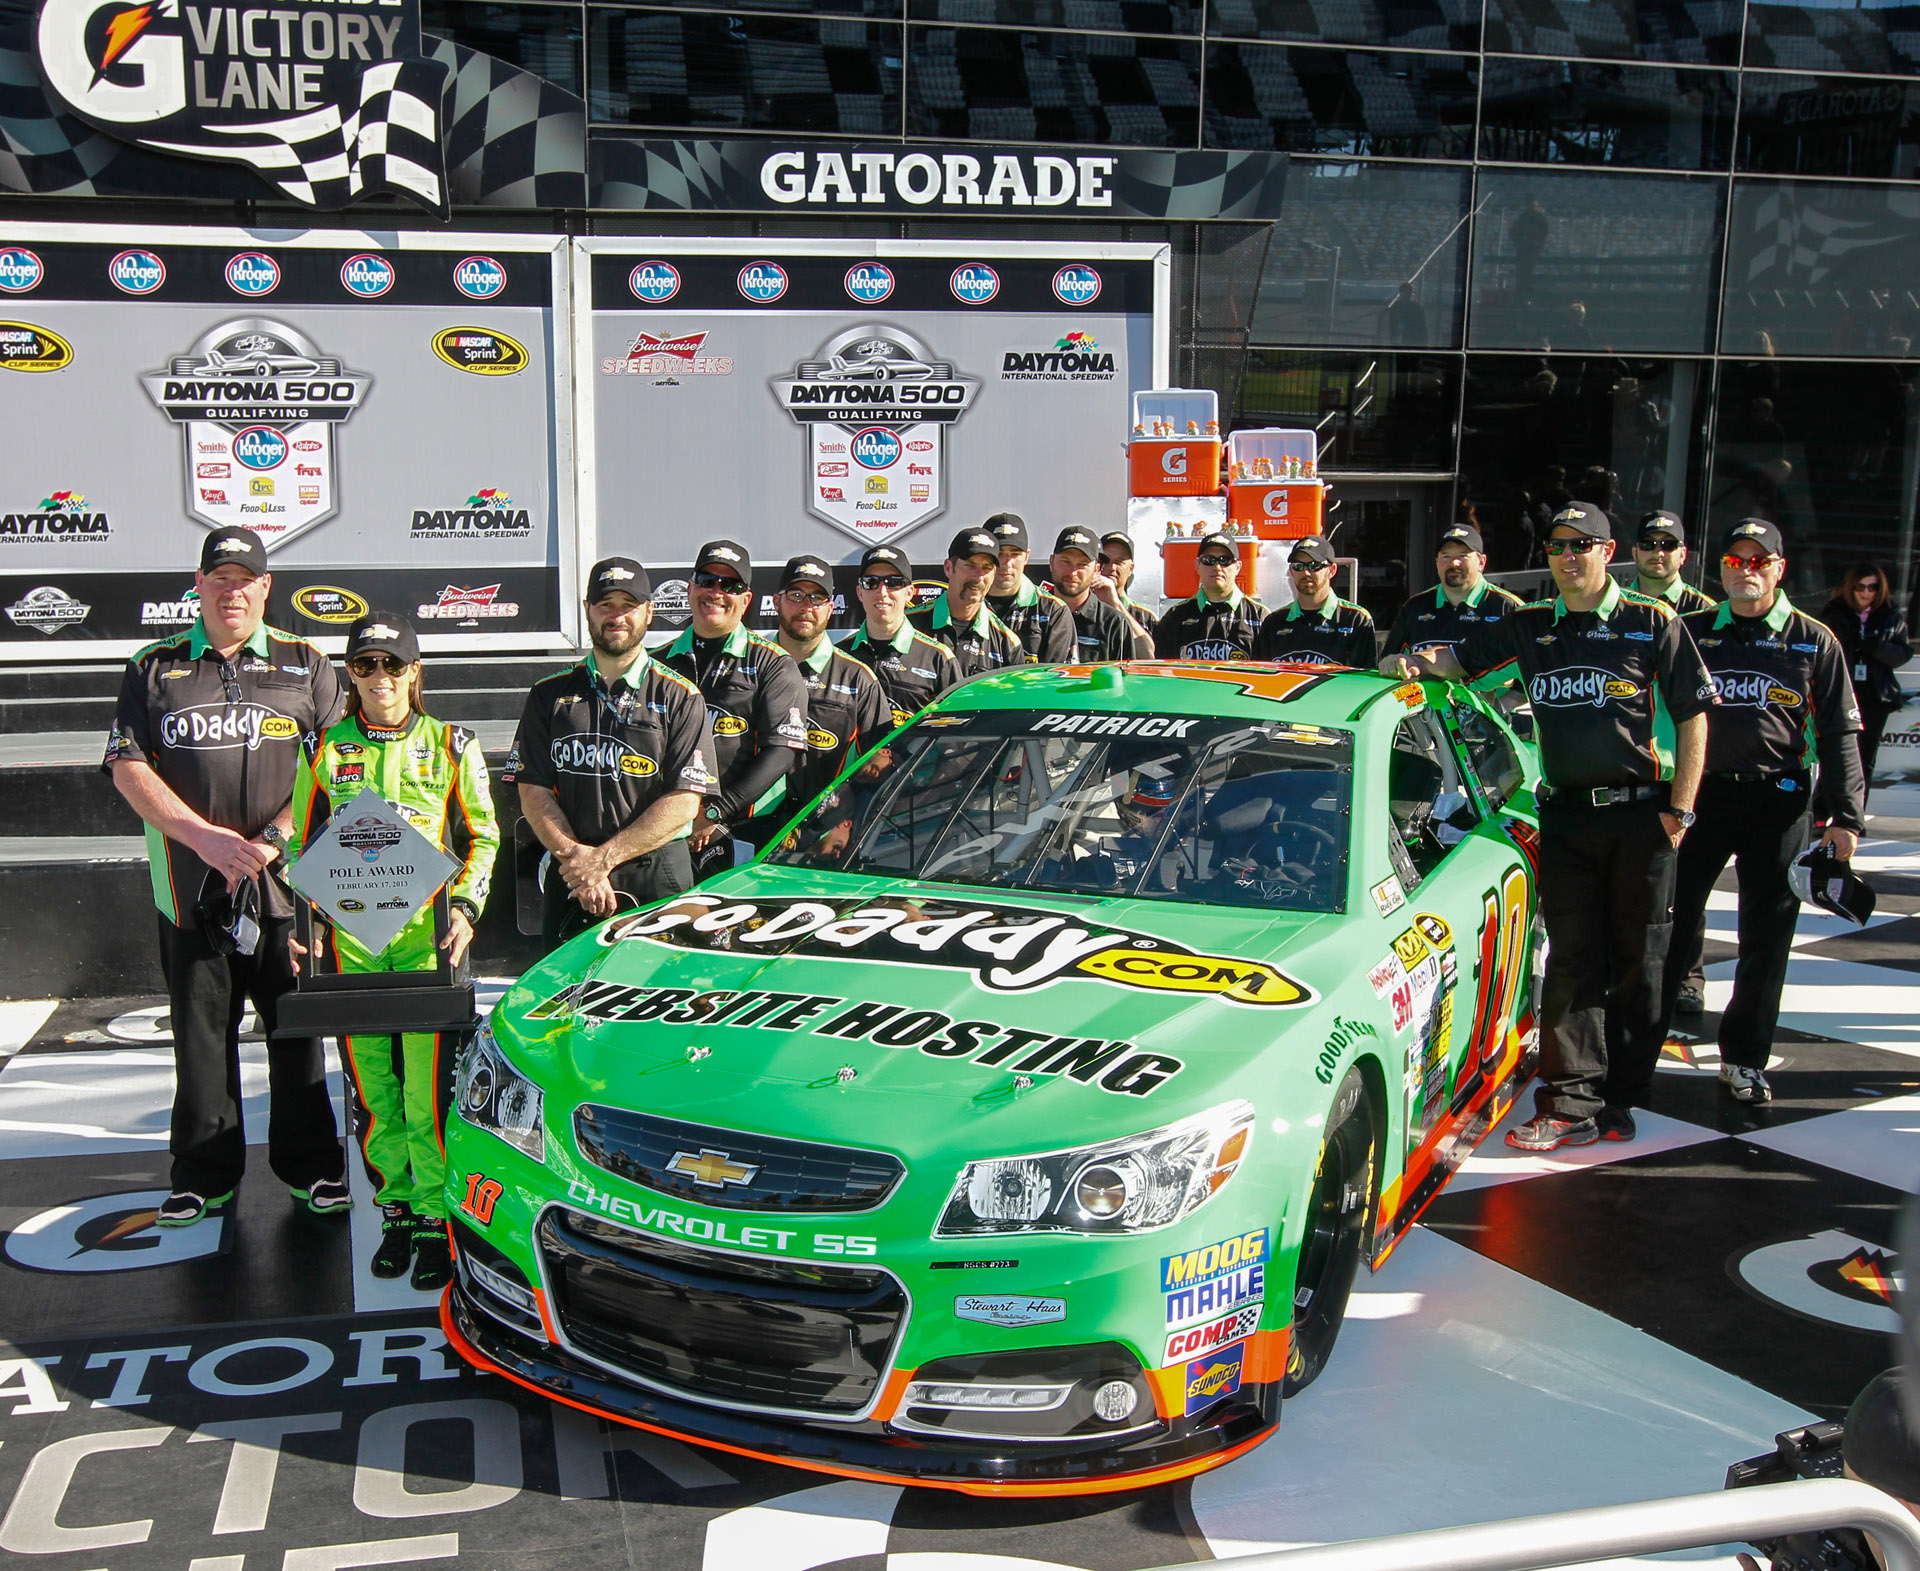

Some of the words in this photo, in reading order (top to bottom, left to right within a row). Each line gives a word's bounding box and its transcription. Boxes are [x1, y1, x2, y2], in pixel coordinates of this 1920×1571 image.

[186, 6, 404, 60] VICTORY
[194, 61, 325, 111] LANE
[760, 151, 1113, 208] GATORADE
[117, 256, 160, 289] Kroger
[234, 258, 275, 290] Kroger
[348, 260, 390, 292] Kroger
[461, 262, 502, 293] Kroger
[636, 265, 677, 297] Kroger
[744, 266, 785, 298] Kroger
[851, 267, 892, 298] Kroger
[957, 268, 997, 299] Kroger
[1058, 269, 1098, 300] Kroger
[4, 343, 38, 357] Sprint
[459, 337, 492, 347] NASCAR
[626, 338, 706, 352] Budweiser
[464, 347, 497, 359] Sprint
[1002, 353, 1115, 372] DAYTONA
[600, 357, 734, 375] SPEEDWEEKS
[1001, 373, 1067, 381] INTERNATIONAL
[1070, 372, 1115, 381] SPEEDWAY
[164, 381, 279, 401] DAYTONA
[283, 382, 355, 402] 500
[789, 385, 896, 404] DAYTONA
[899, 386, 965, 404] 500
[205, 408, 310, 418] QUALIFYING
[827, 410, 923, 420] QUALIFYING
[197, 441, 228, 453] Smith's
[239, 432, 285, 466] Kroger
[819, 442, 847, 452] Smith's
[857, 433, 899, 465] Kroger
[1161, 447, 1187, 475] G
[1262, 490, 1288, 518] G
[0, 513, 109, 534] AYTONA
[410, 510, 530, 530] DAYTONA
[0, 535, 55, 543] RNATIONAL
[59, 534, 109, 543] SPEEDWAY
[409, 531, 481, 540] INTERNATIONAL
[483, 530, 531, 539] SPEEDWAY
[314, 593, 340, 602] NASCAR
[437, 589, 499, 602] Budweiser
[918, 587, 943, 596] NASCAR
[14, 609, 57, 617] DAYTONA
[58, 608, 85, 617] 500
[317, 603, 344, 613] Sprint
[417, 602, 520, 619] SPEEDWEEKS
[654, 601, 683, 609] YTONA
[1029, 713, 1200, 739] PATRICK
[1880, 732, 1920, 744] AYTO
[336, 764, 363, 776] Coke
[338, 833, 377, 841] DAYTONA
[377, 831, 401, 839] 500
[329, 867, 365, 879] POLE
[367, 865, 415, 878] AWARD
[336, 882, 379, 891] FEBRUARY
[380, 881, 391, 889] 17,
[392, 880, 409, 888] 2013
[1392, 981, 1413, 1032] 3M
[527, 980, 847, 1032] WEBSITE
[815, 1001, 1185, 1099] HOSTING
[1315, 1019, 1379, 1085] GOODYEAR
[460, 1172, 504, 1226] 10
[567, 1180, 798, 1250] CHEVROLET
[813, 1234, 878, 1256] SS
[1165, 1229, 1266, 1285] MOOG
[1167, 1265, 1264, 1323] MAHLE
[959, 1298, 1019, 1312] Stewart
[1026, 1300, 1062, 1312] Haas
[1168, 1315, 1238, 1359] COMP
[1216, 1326, 1248, 1346] CAMS
[1190, 1362, 1239, 1394] SUNOCO
